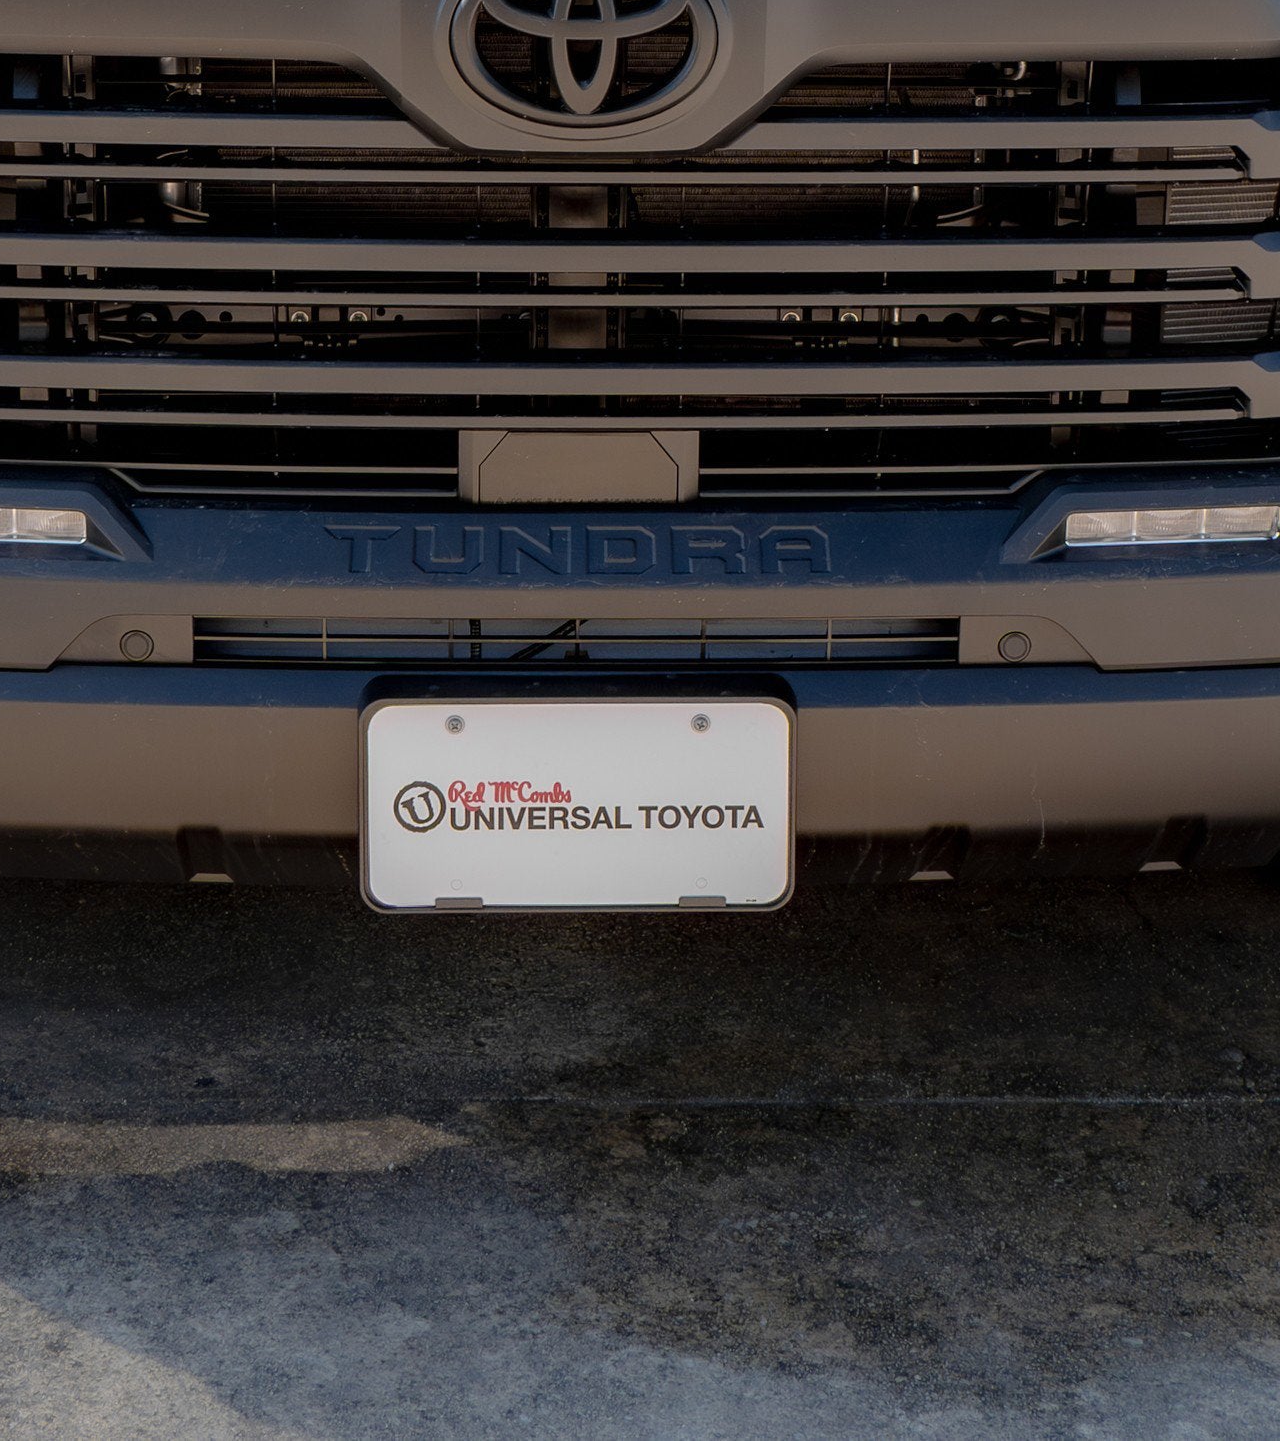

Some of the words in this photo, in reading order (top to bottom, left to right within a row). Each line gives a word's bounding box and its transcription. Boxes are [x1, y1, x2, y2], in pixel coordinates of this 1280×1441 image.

[323, 525, 832, 575] TUNDRA
[448, 780, 486, 812] Red
[488, 781, 572, 804] McCombs
[450, 805, 632, 831] UNIVERSAL
[638, 805, 764, 830] TOYOTA
